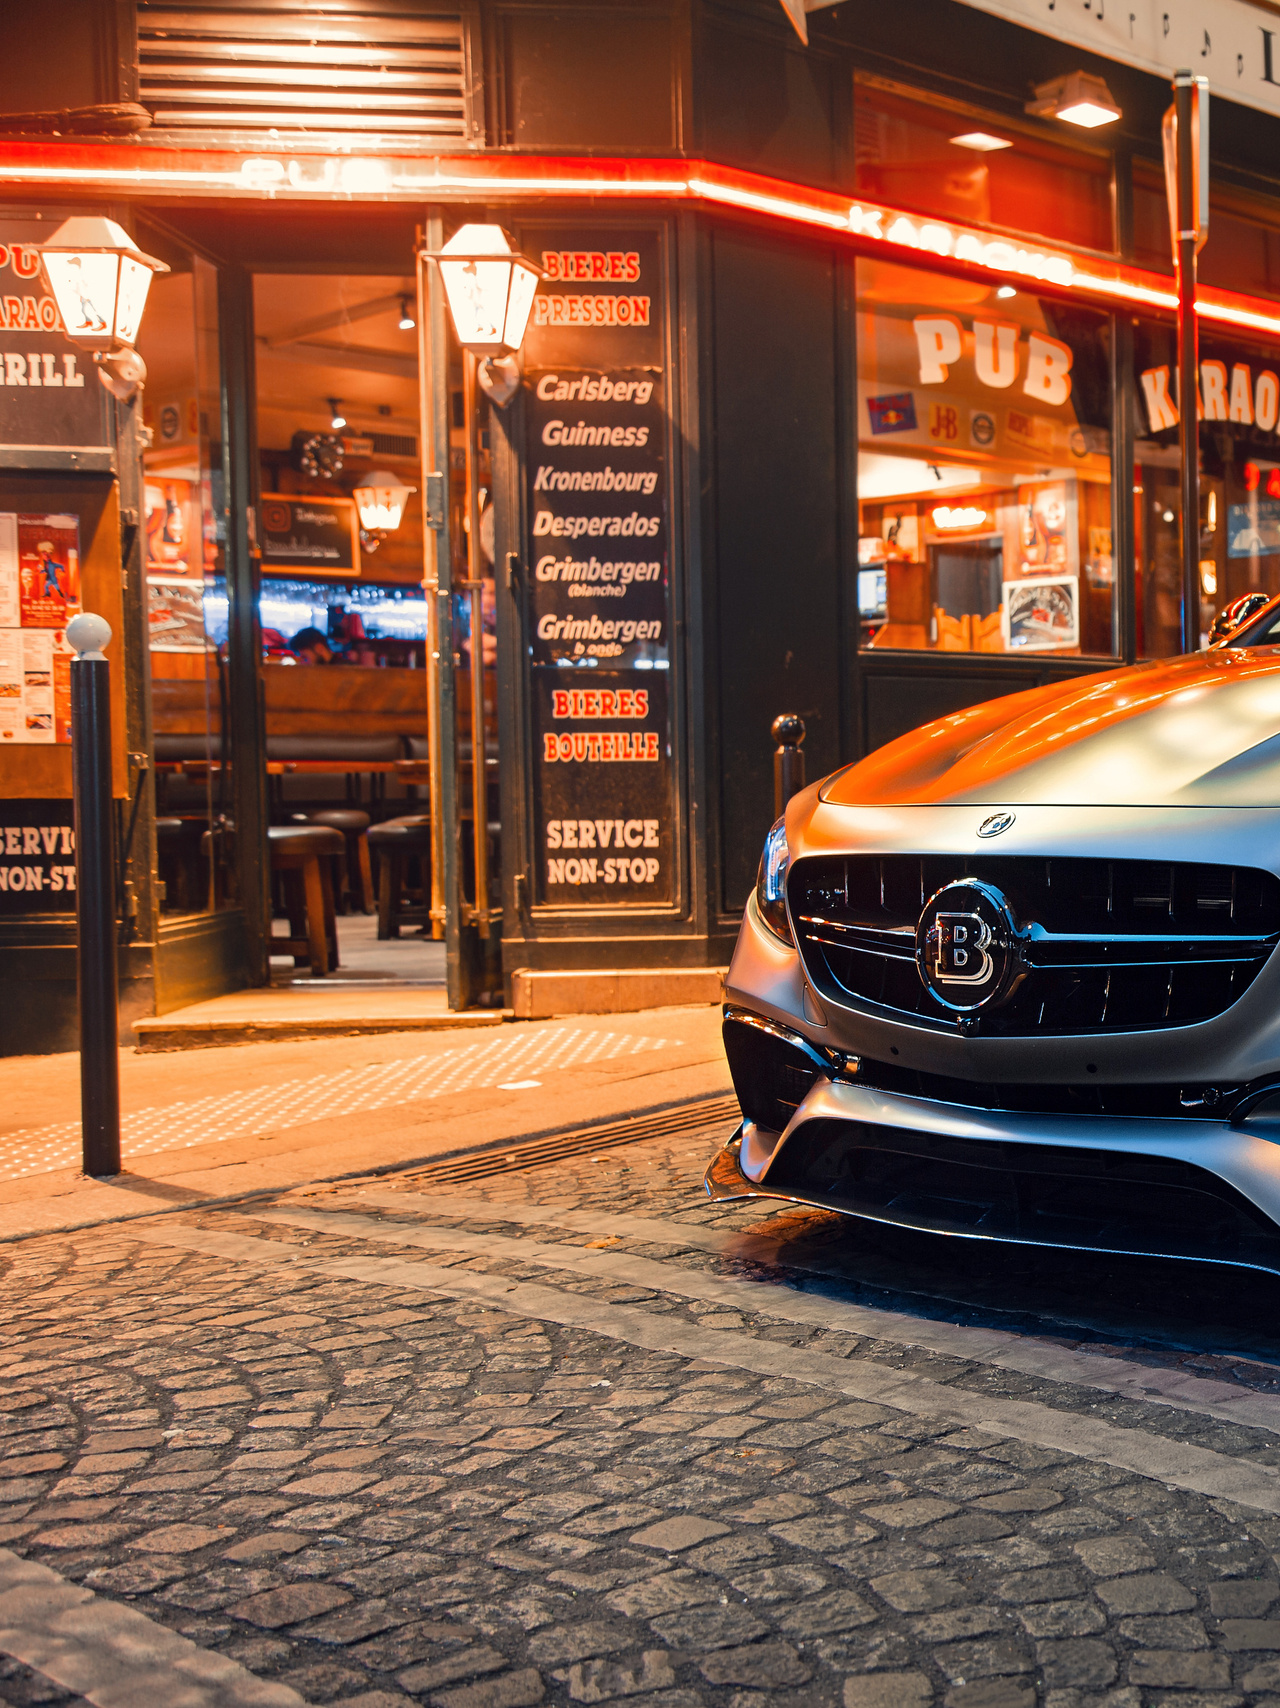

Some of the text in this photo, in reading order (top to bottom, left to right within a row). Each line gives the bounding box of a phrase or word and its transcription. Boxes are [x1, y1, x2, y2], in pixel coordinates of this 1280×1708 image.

[541, 250, 641, 283] BIERES
[534, 294, 651, 327] PRESSION
[0, 352, 85, 388] RILL
[913, 312, 1074, 407] PUB
[536, 374, 654, 405] Carlsberg
[541, 419, 650, 447] Guinness
[533, 465, 659, 495] Kronenbourg
[532, 510, 661, 540] Desperados
[535, 554, 662, 585] Grimbergen
[567, 582, 628, 599] (blanche)
[536, 613, 663, 643] Grimbergen
[573, 641, 625, 658] bonde
[551, 688, 650, 720] BIERES
[543, 731, 660, 763] BOUTEILLE
[546, 818, 661, 850] SERVICE
[546, 857, 661, 885] NON-STOP
